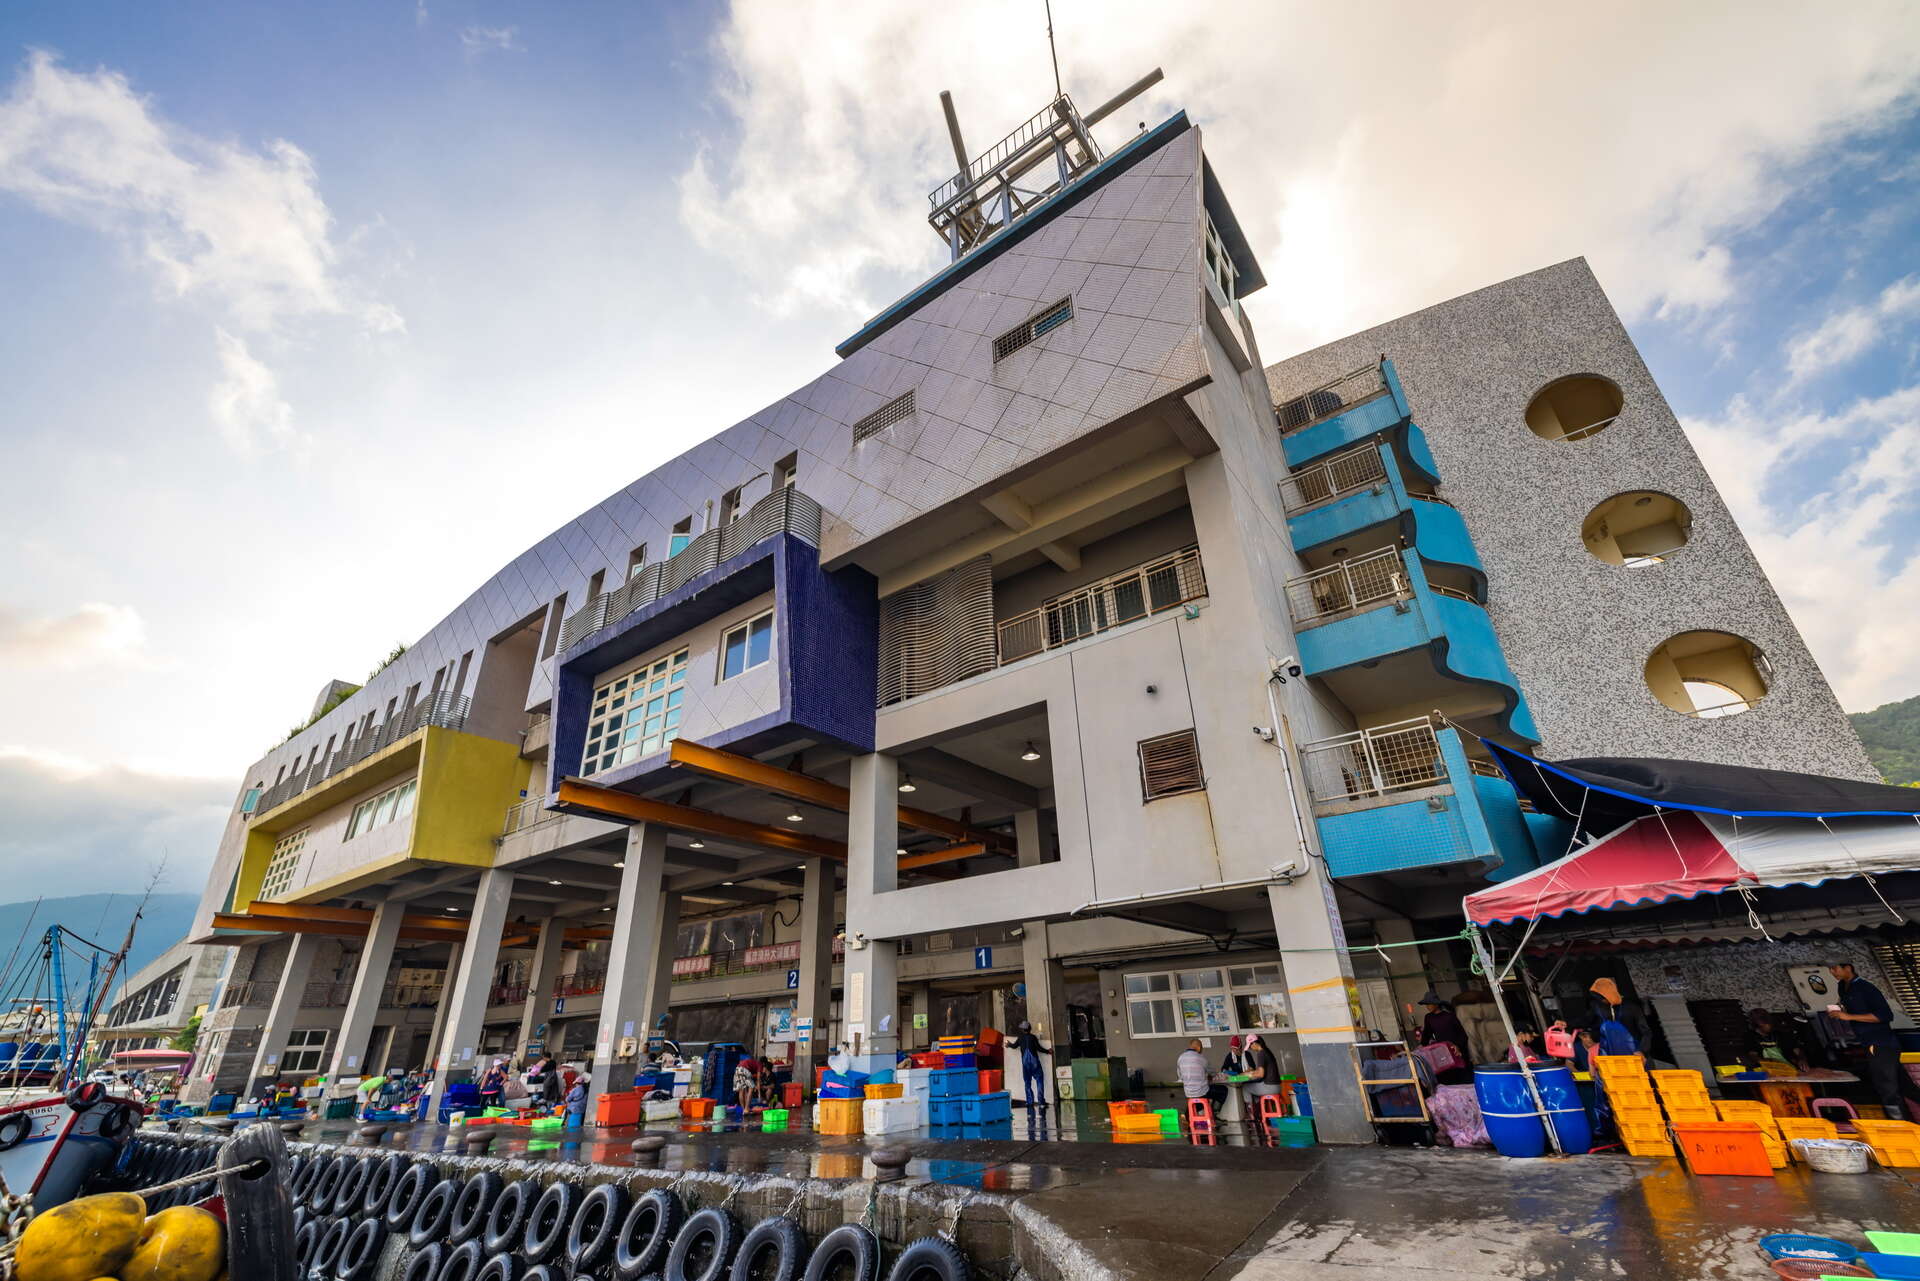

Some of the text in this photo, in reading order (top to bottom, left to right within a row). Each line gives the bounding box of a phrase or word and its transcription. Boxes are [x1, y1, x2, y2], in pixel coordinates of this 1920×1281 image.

[978, 948, 986, 967] 1
[790, 972, 797, 987] 2
[556, 1001, 562, 1013] 4
